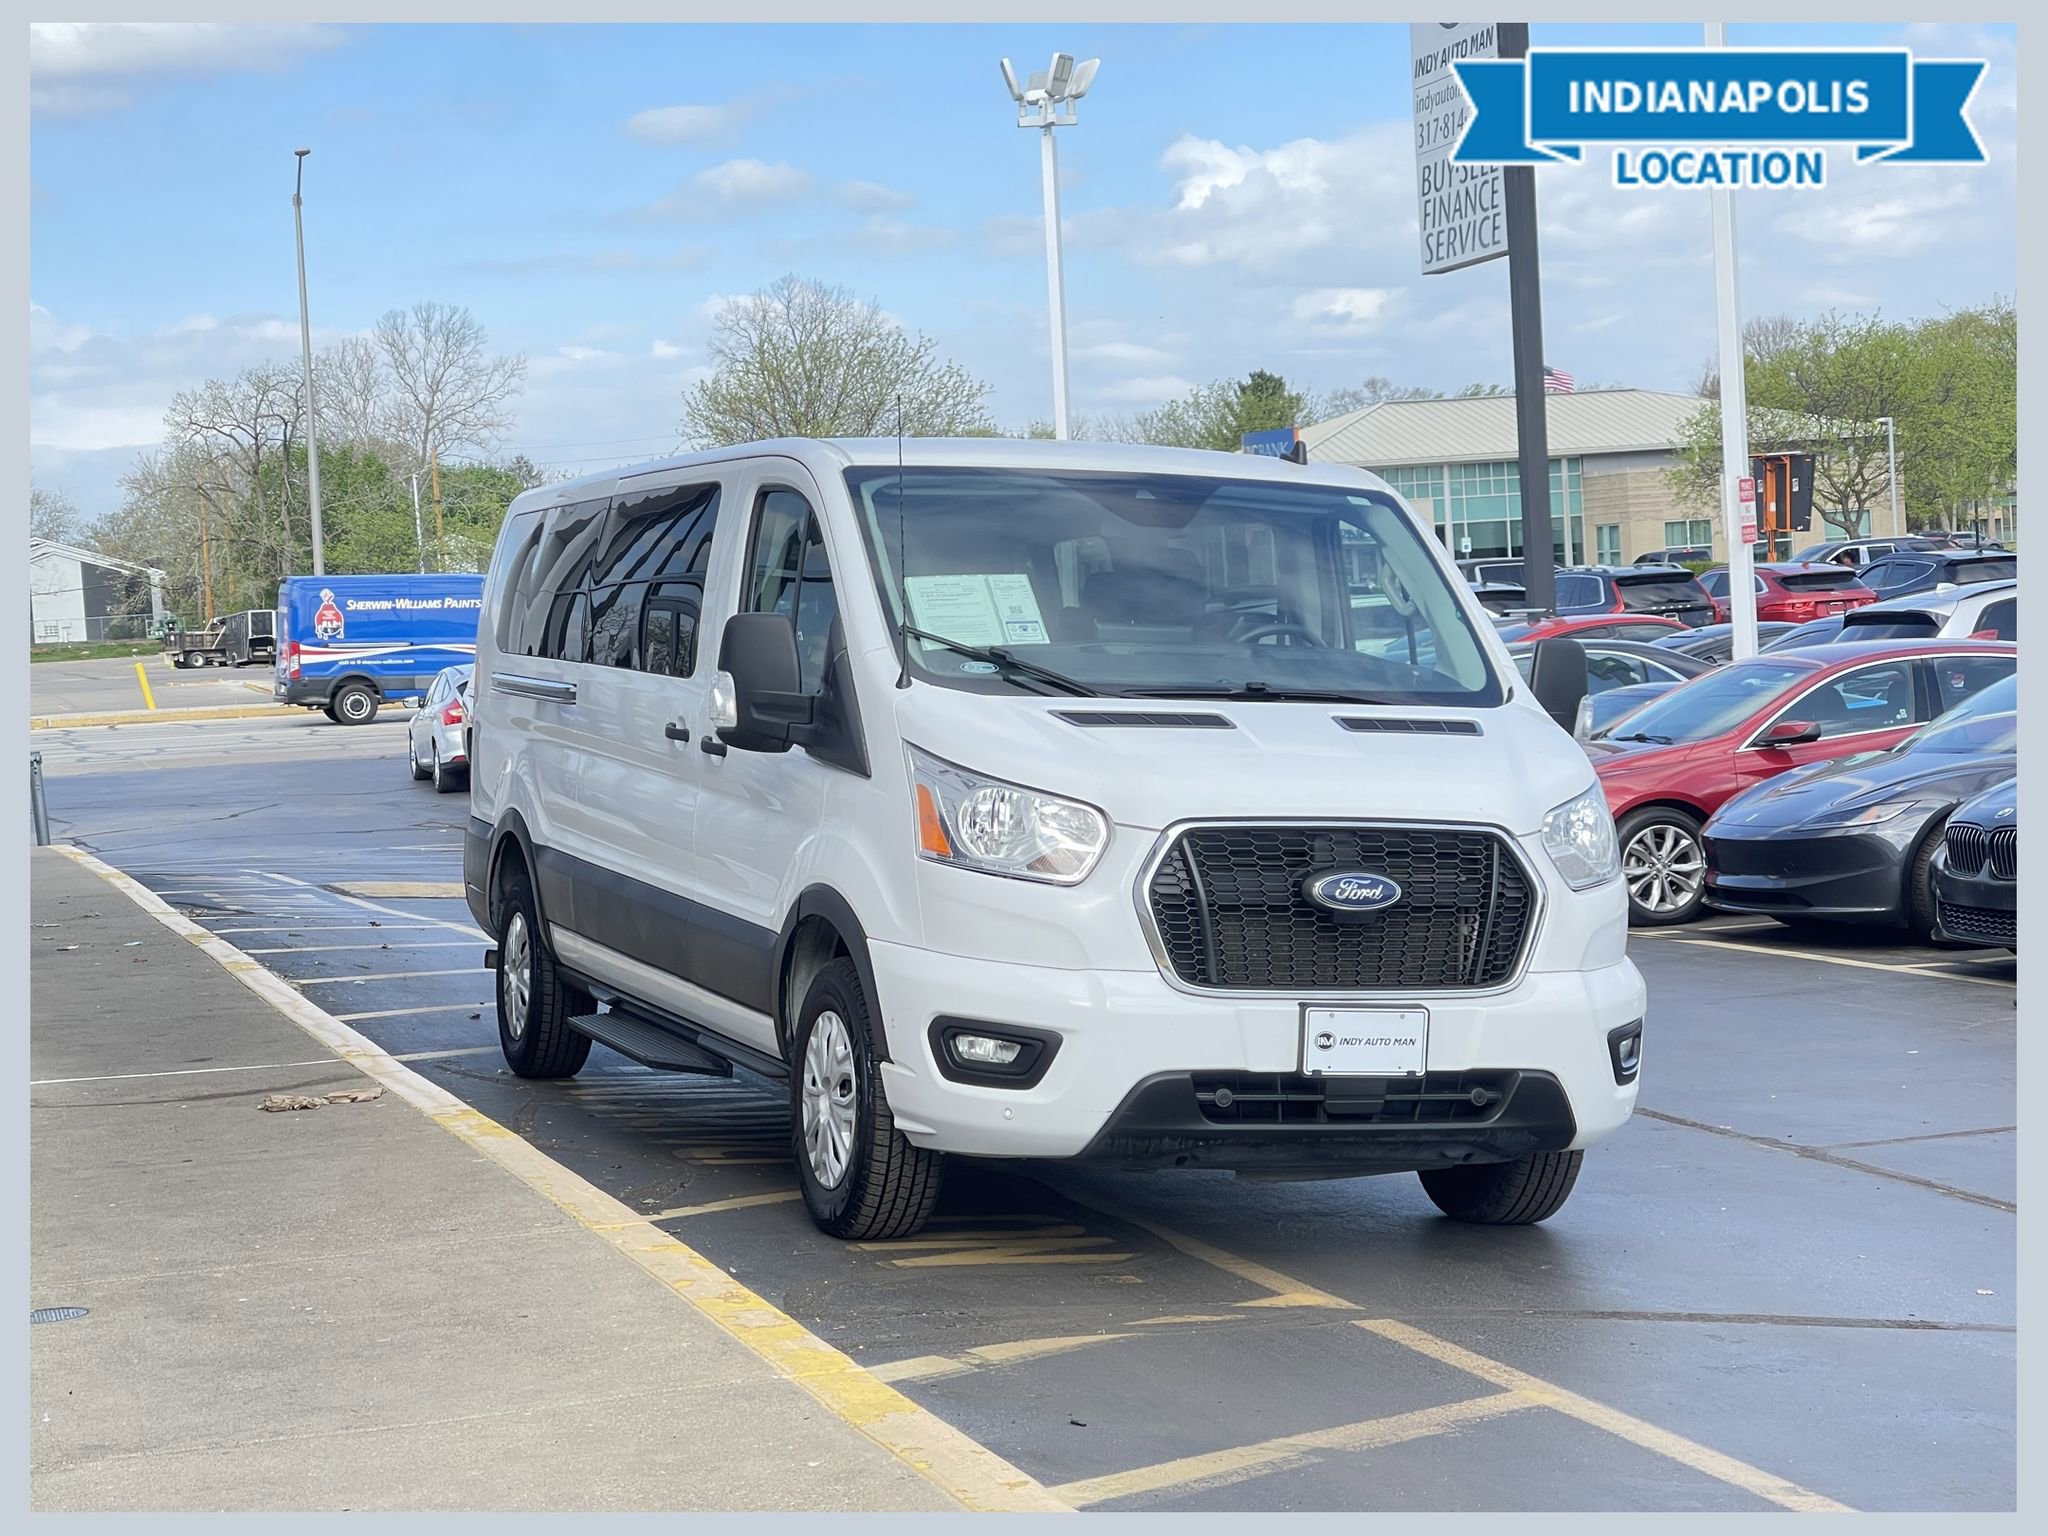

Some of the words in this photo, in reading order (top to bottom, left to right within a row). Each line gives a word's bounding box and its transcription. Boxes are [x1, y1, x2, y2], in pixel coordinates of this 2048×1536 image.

[1414, 50, 1440, 79] INDY
[1440, 38, 1468, 69] AUTO
[1469, 25, 1495, 56] MAN
[1423, 175, 1500, 232] FINANCE
[1424, 212, 1501, 265] SERVICE
[345, 598, 442, 611] SHERWIN-WILLIAMS
[444, 597, 482, 609] PAINTS
[1335, 878, 1384, 900] Ford
[1339, 1037, 1364, 1047] INDY
[1364, 1037, 1392, 1047] AUTO
[1393, 1038, 1417, 1047] MAN
